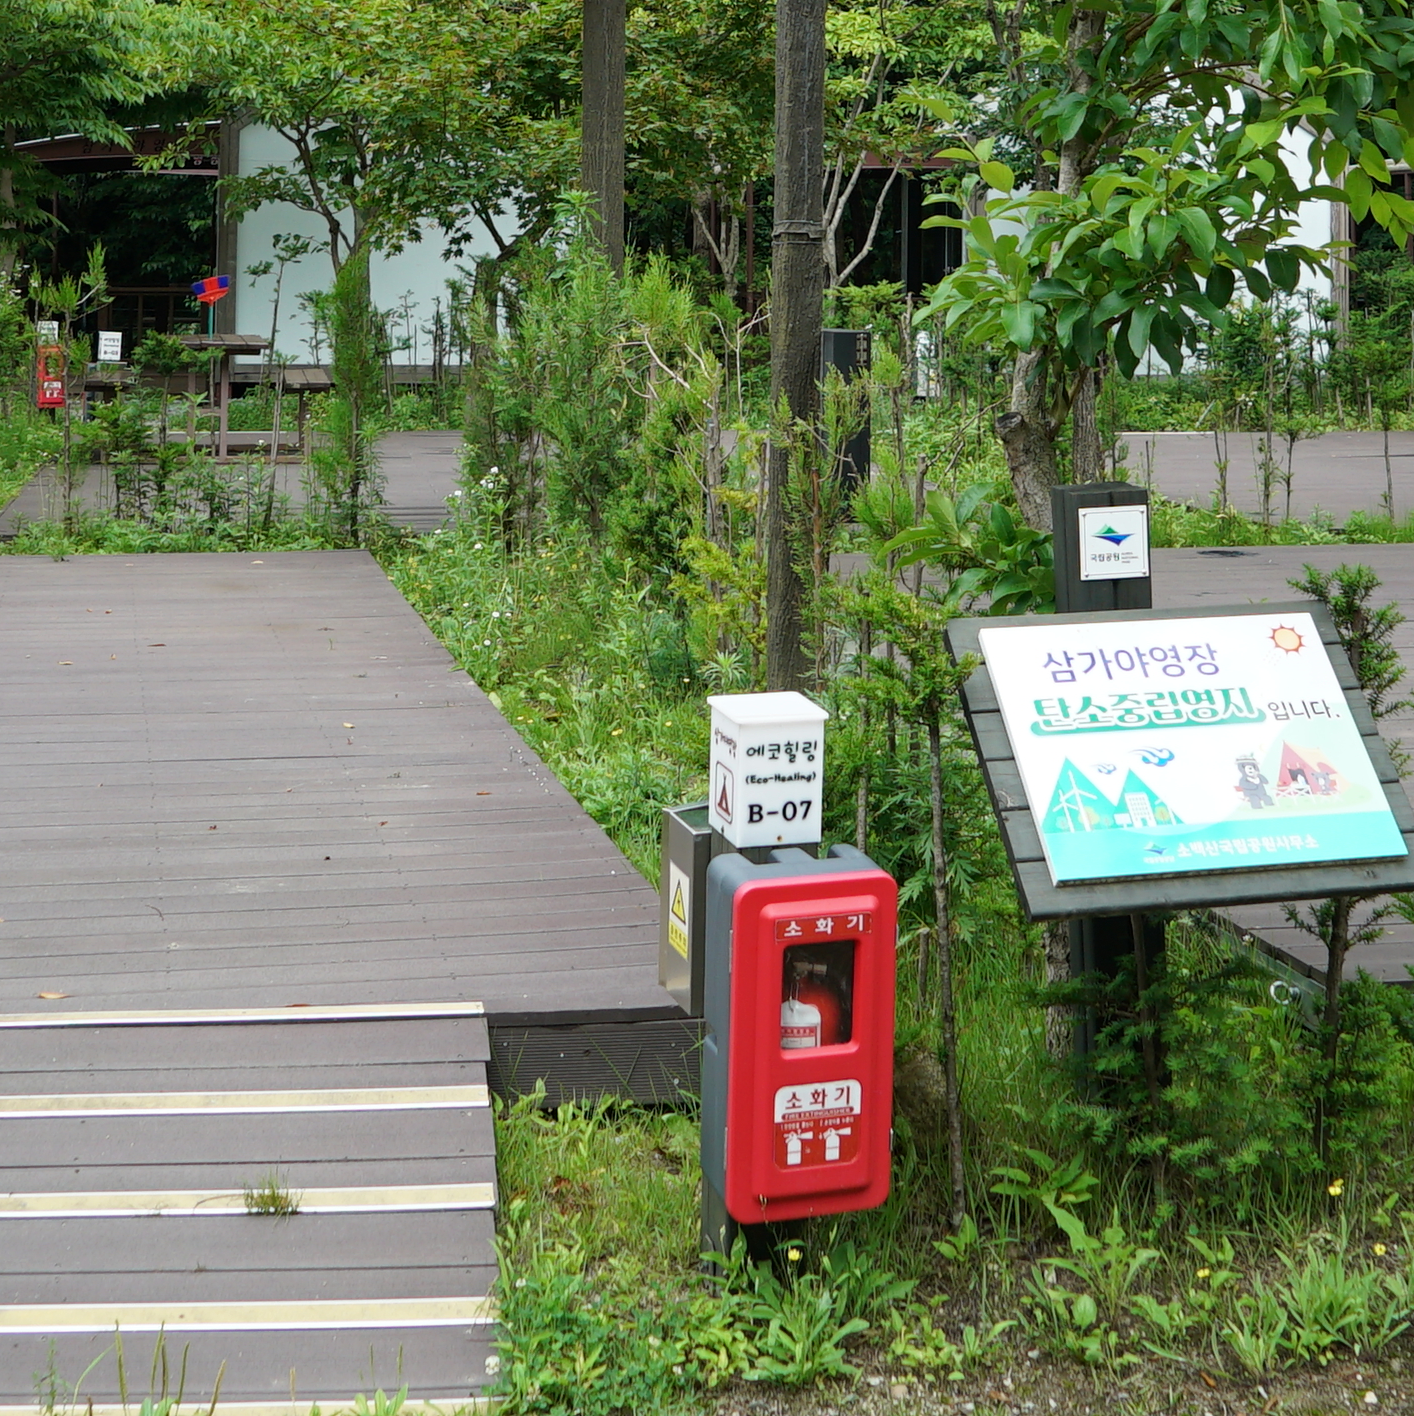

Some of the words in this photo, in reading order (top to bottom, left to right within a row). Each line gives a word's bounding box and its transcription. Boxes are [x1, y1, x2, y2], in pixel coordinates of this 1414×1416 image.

[1042, 643, 1220, 683] 삼가야영장
[1033, 687, 1257, 728] 탄소중립영지
[1268, 699, 1341, 721] 입니다.
[746, 740, 817, 763] 에코힐링
[745, 771, 816, 785] (Eco-Healing)
[747, 800, 812, 824] B-07
[785, 1085, 850, 1110] 소화기
